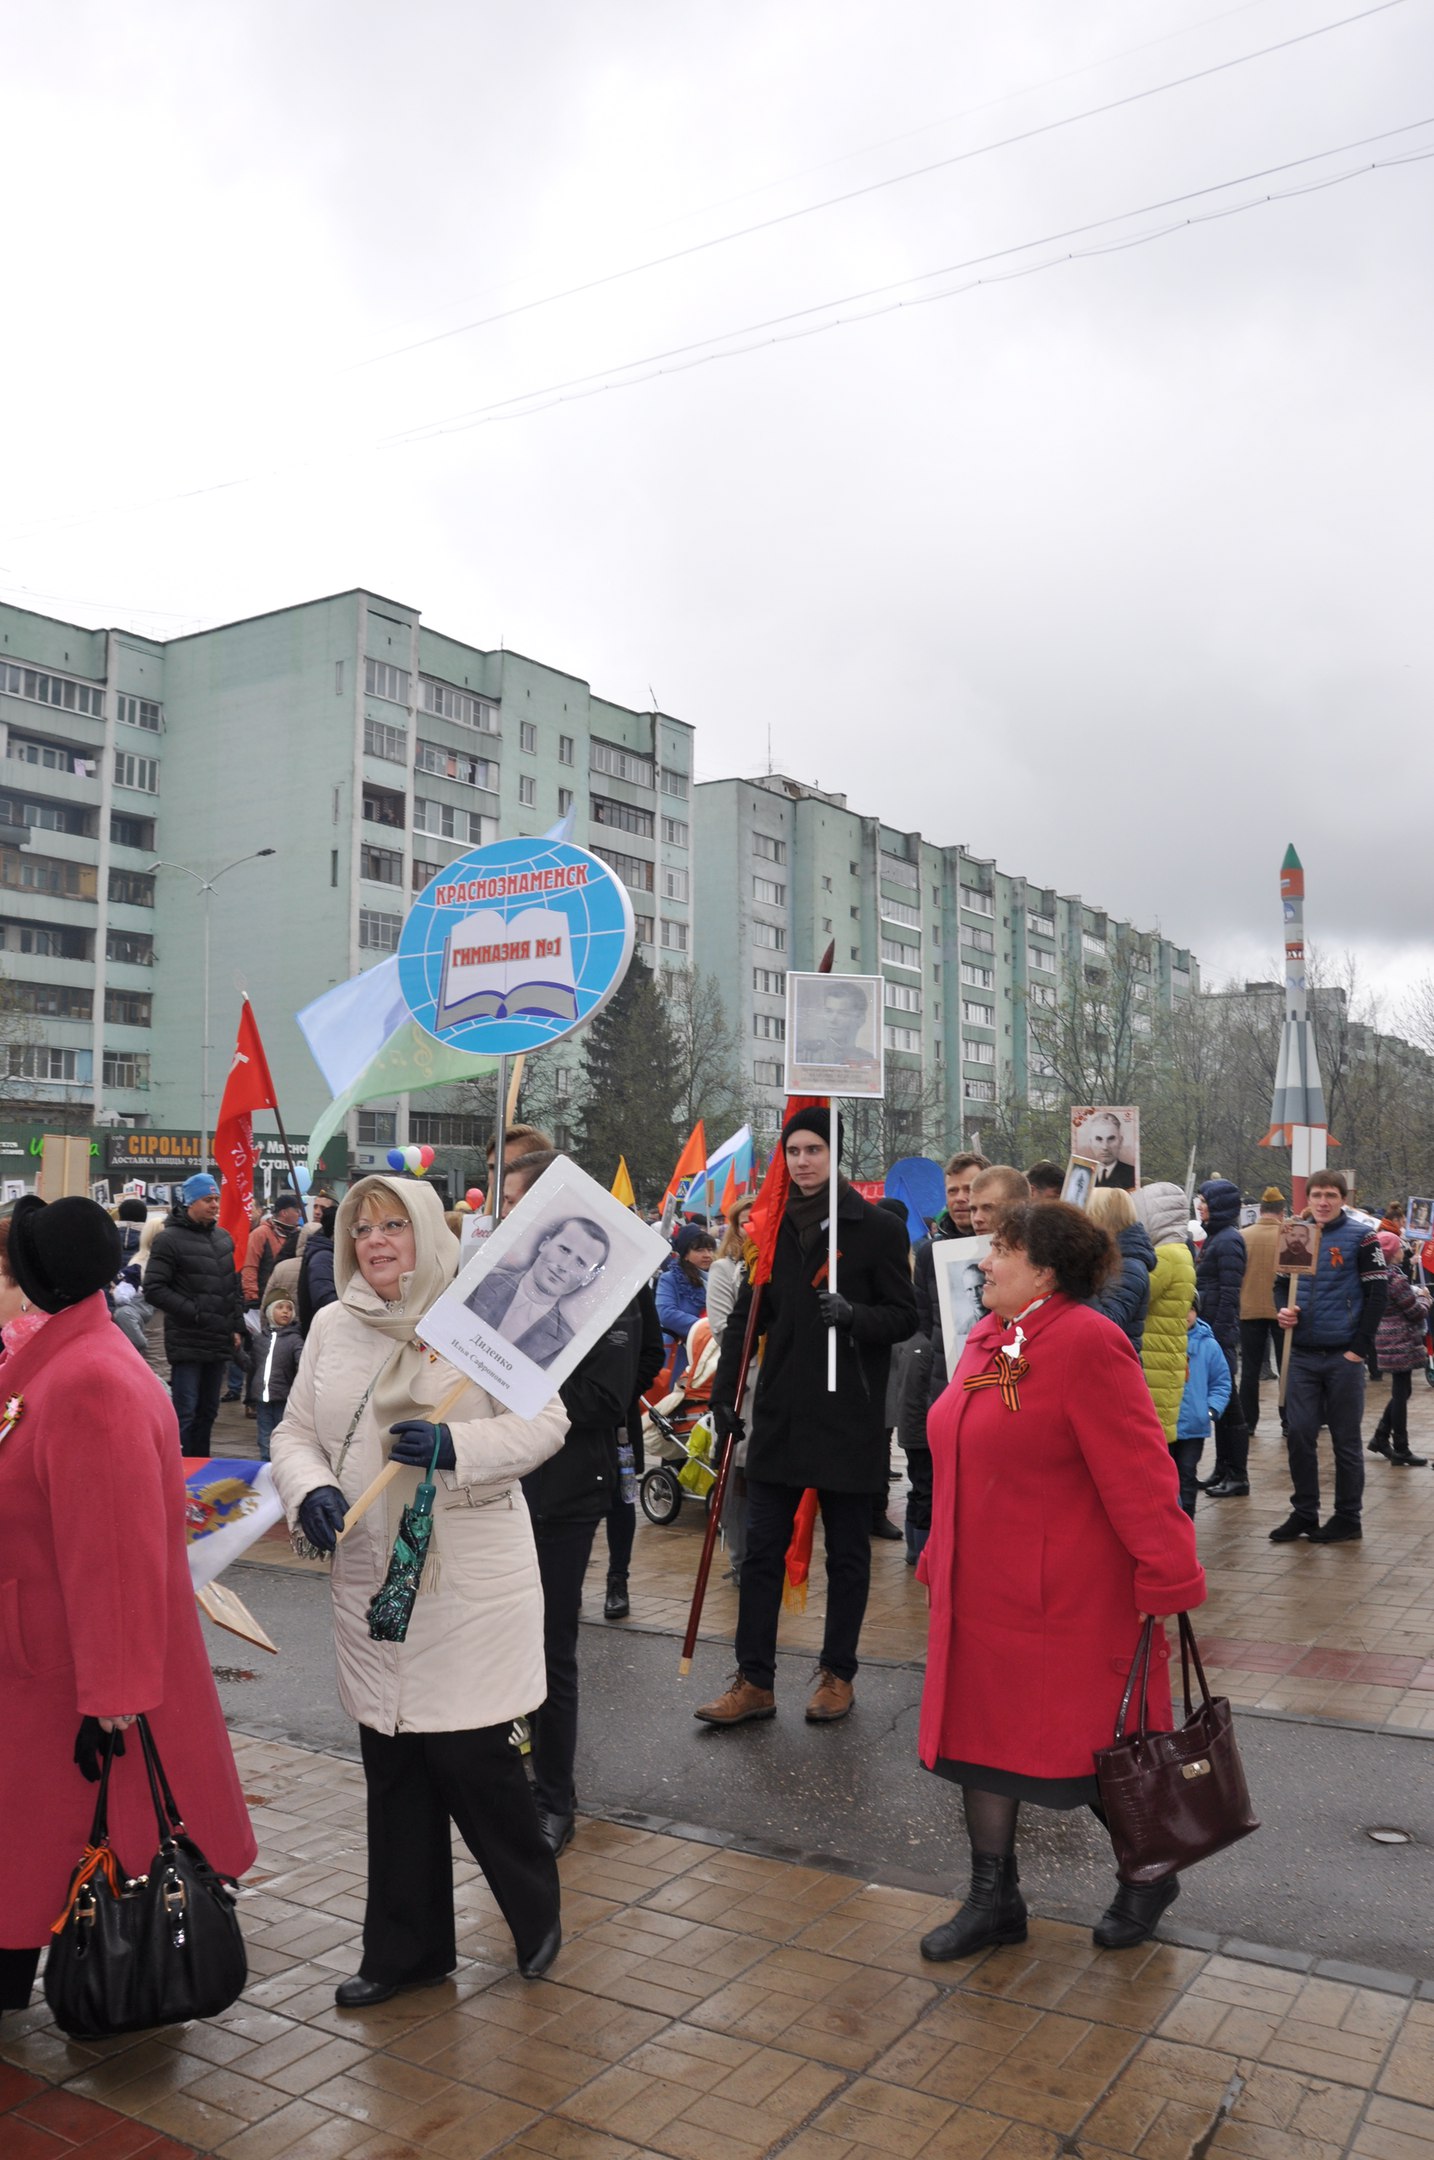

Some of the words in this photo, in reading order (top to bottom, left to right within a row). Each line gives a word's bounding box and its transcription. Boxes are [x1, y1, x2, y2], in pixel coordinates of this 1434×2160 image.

[436, 864, 588, 906] КРАСНОЗНАМЕНСК
[452, 938, 531, 967] ГИМНАЗИЯ
[536, 937, 562, 959] №1
[266, 1140, 310, 1154] Мясно
[451, 1339, 470, 1357] Илья
[469, 1334, 513, 1371] Диденко
